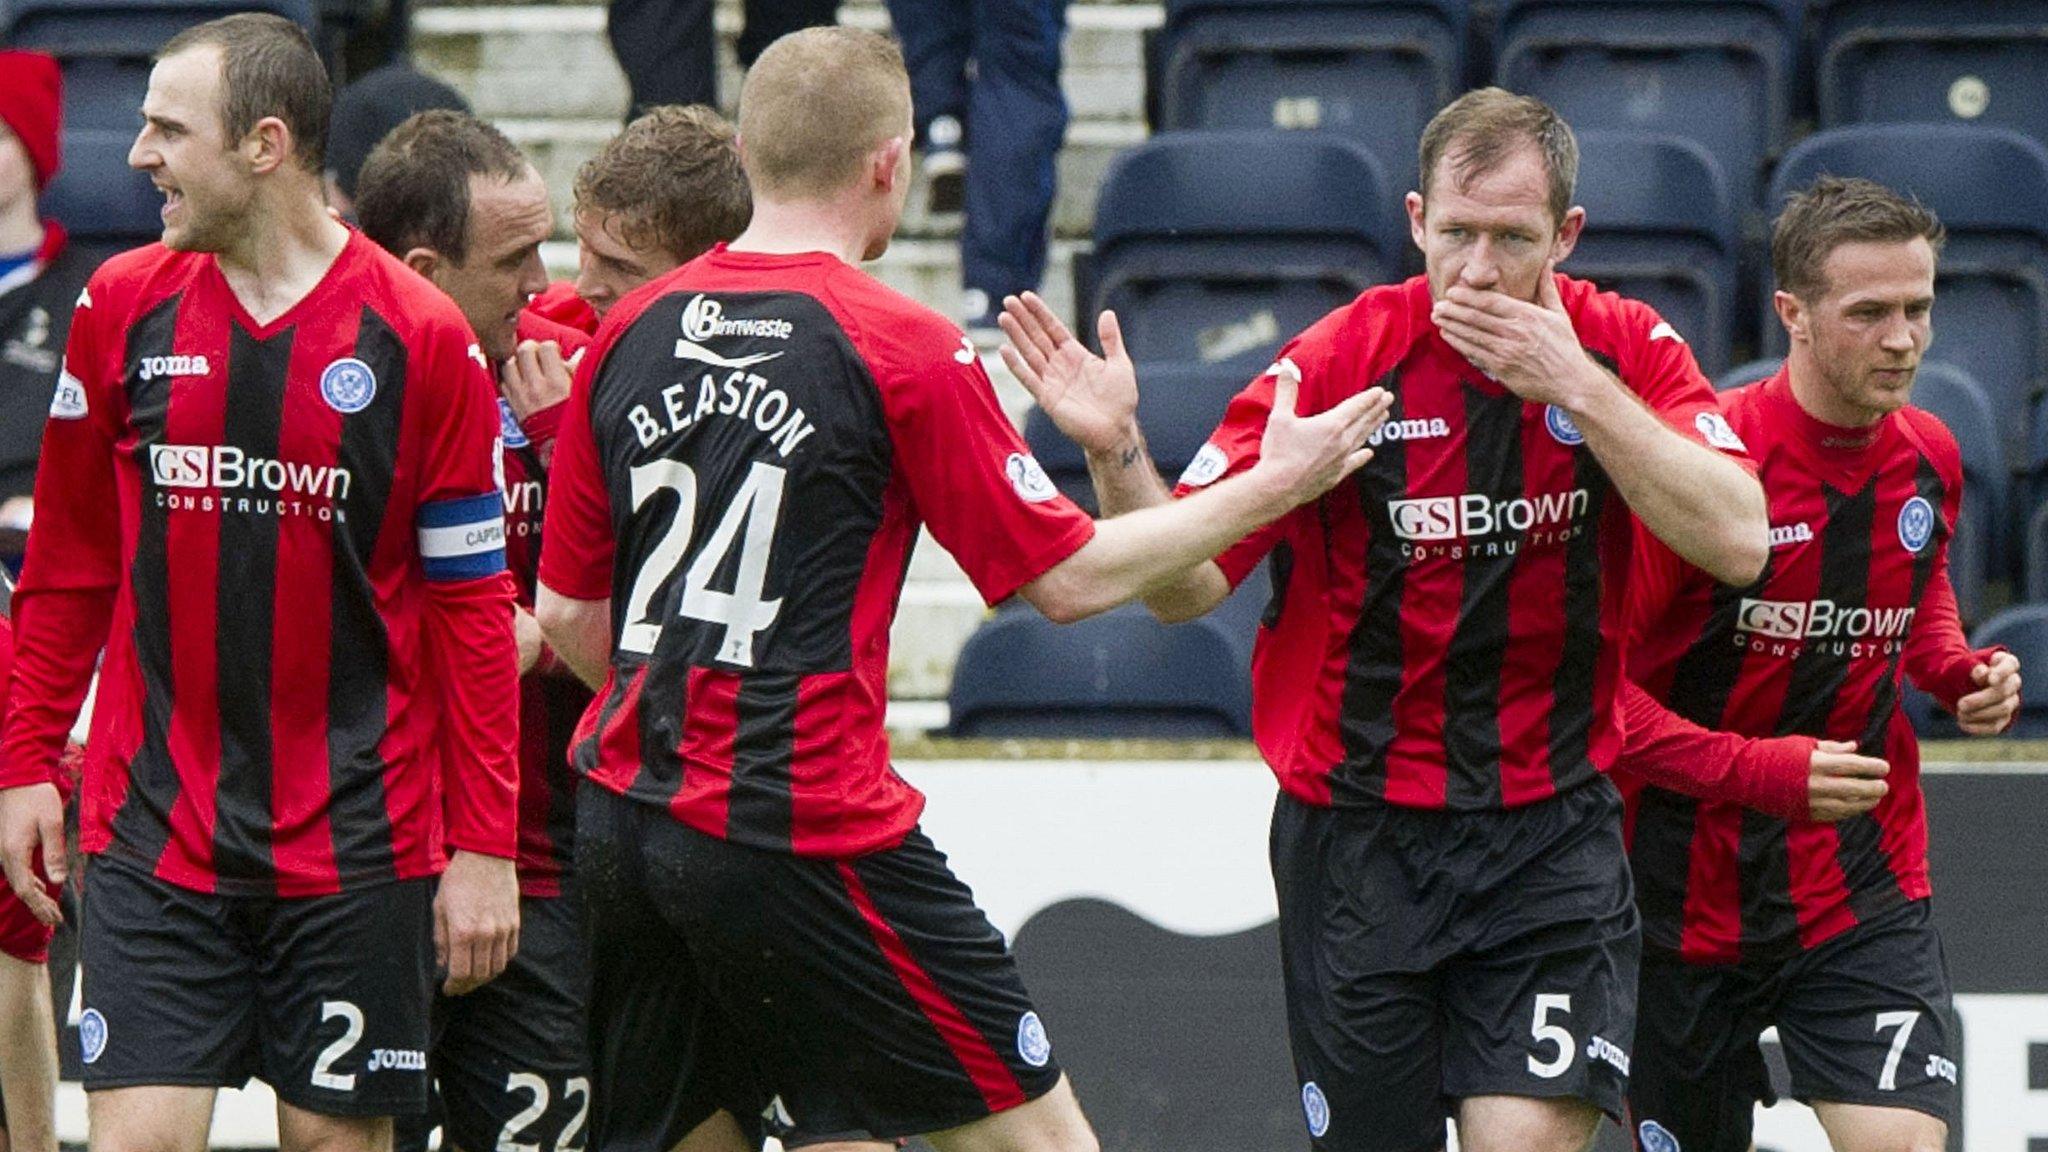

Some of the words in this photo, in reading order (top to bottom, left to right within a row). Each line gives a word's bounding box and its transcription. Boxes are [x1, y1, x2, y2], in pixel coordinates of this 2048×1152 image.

[690, 299, 793, 340] Binnwaste
[628, 371, 816, 458] B.EASTON
[152, 447, 205, 485] GS
[212, 446, 351, 499] Brown
[156, 492, 346, 524] CONSTRUCTION
[1391, 499, 1454, 537] GS
[1459, 488, 1588, 536] Brown
[619, 458, 786, 667] 24
[1401, 525, 1583, 560] CONSTRUTION
[1740, 602, 1803, 636] GS
[311, 1001, 364, 1091] 2
[1527, 993, 1576, 1078] 5
[1875, 1010, 1921, 1091] 7
[496, 1072, 590, 1152] 22
